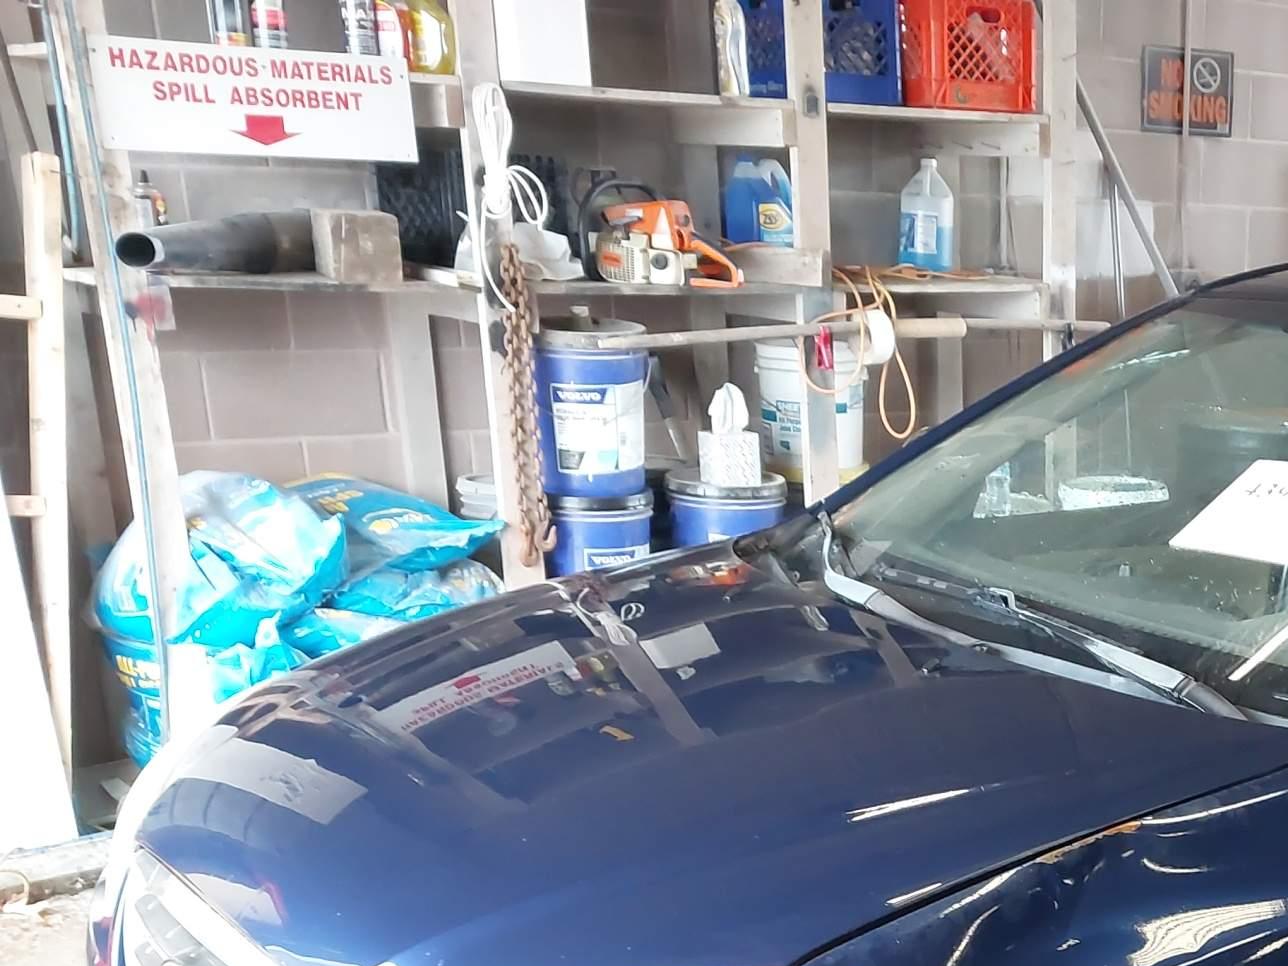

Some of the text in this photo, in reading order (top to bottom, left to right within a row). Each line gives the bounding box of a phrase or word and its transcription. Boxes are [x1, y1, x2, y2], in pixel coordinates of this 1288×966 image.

[108, 47, 393, 86] HAZARDOUS MATERIALS
[152, 81, 362, 111] SPILL ABSORBENT
[556, 390, 602, 402] VOLVO
